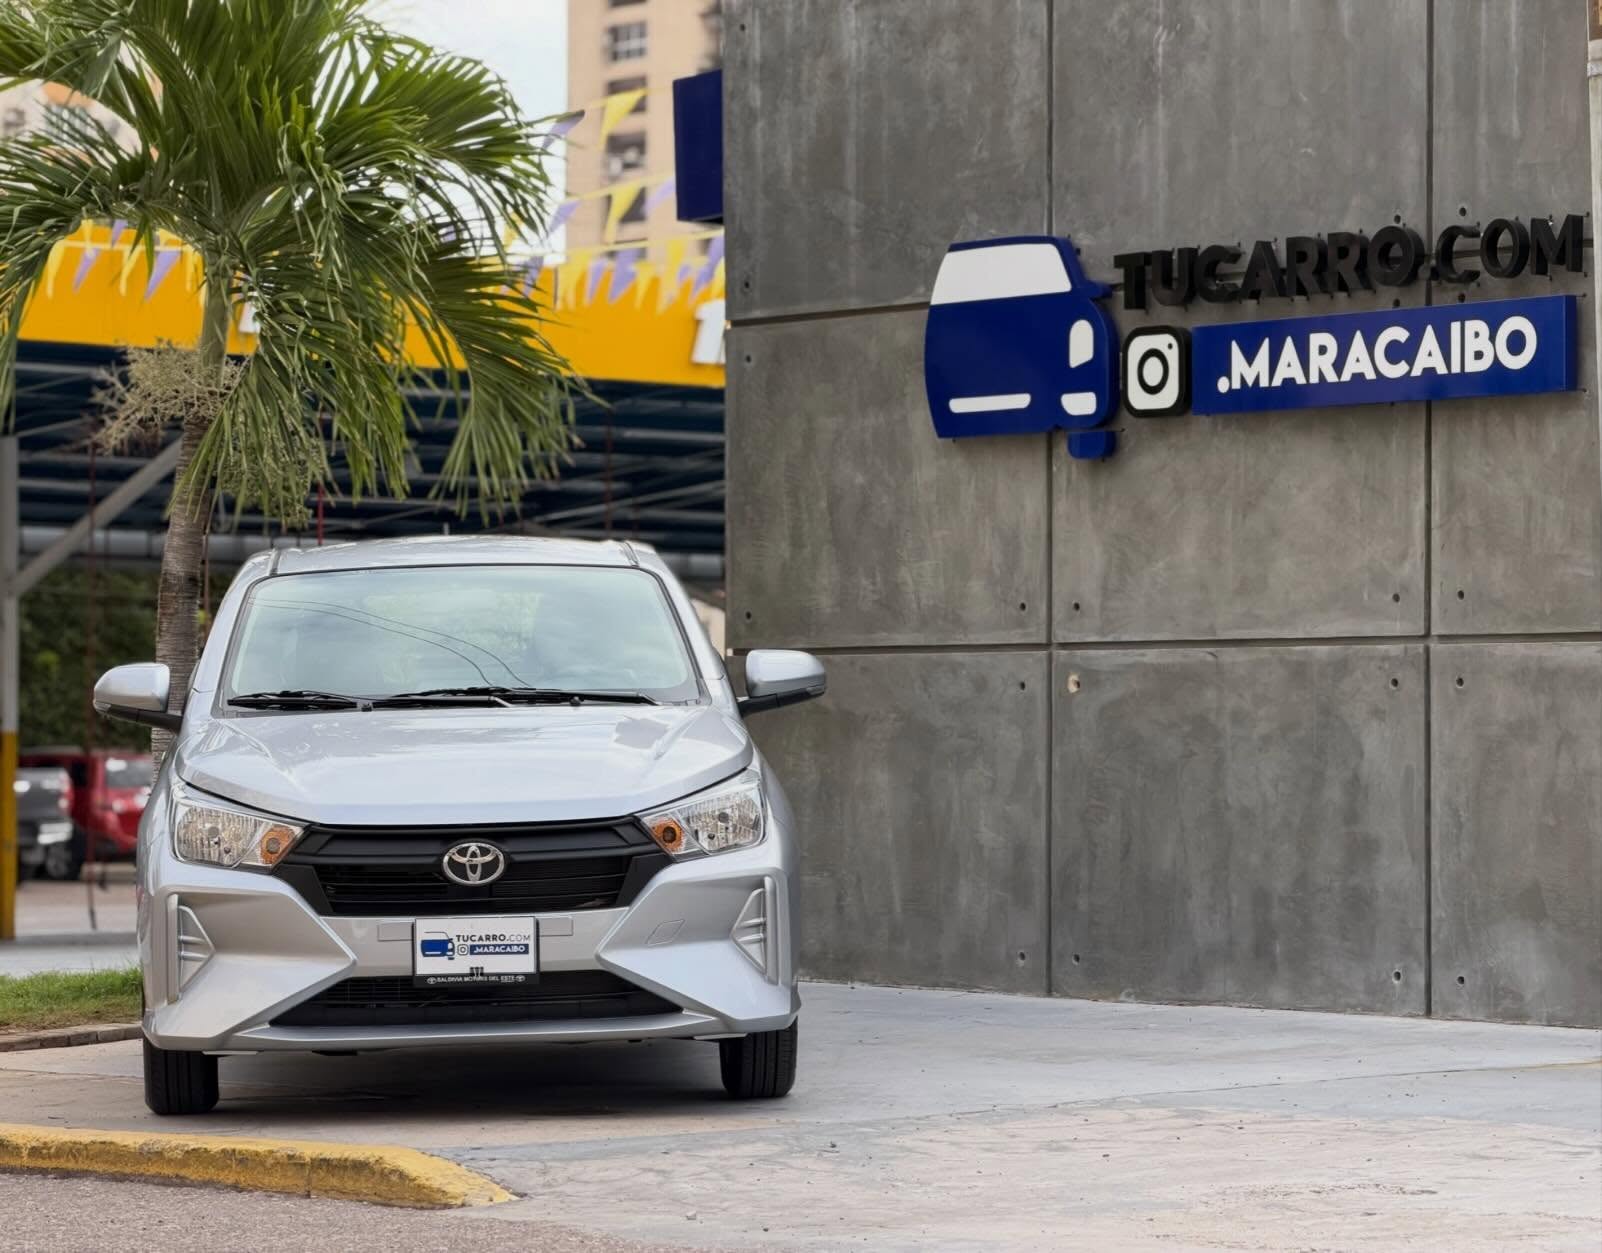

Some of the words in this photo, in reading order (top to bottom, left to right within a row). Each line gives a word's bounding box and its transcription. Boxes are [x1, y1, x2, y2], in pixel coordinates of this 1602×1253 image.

[1114, 214, 1585, 310] TUCARRO.COM
[1217, 315, 1538, 394] .MARACAIBO
[456, 934, 531, 942] TUCARRO.COM
